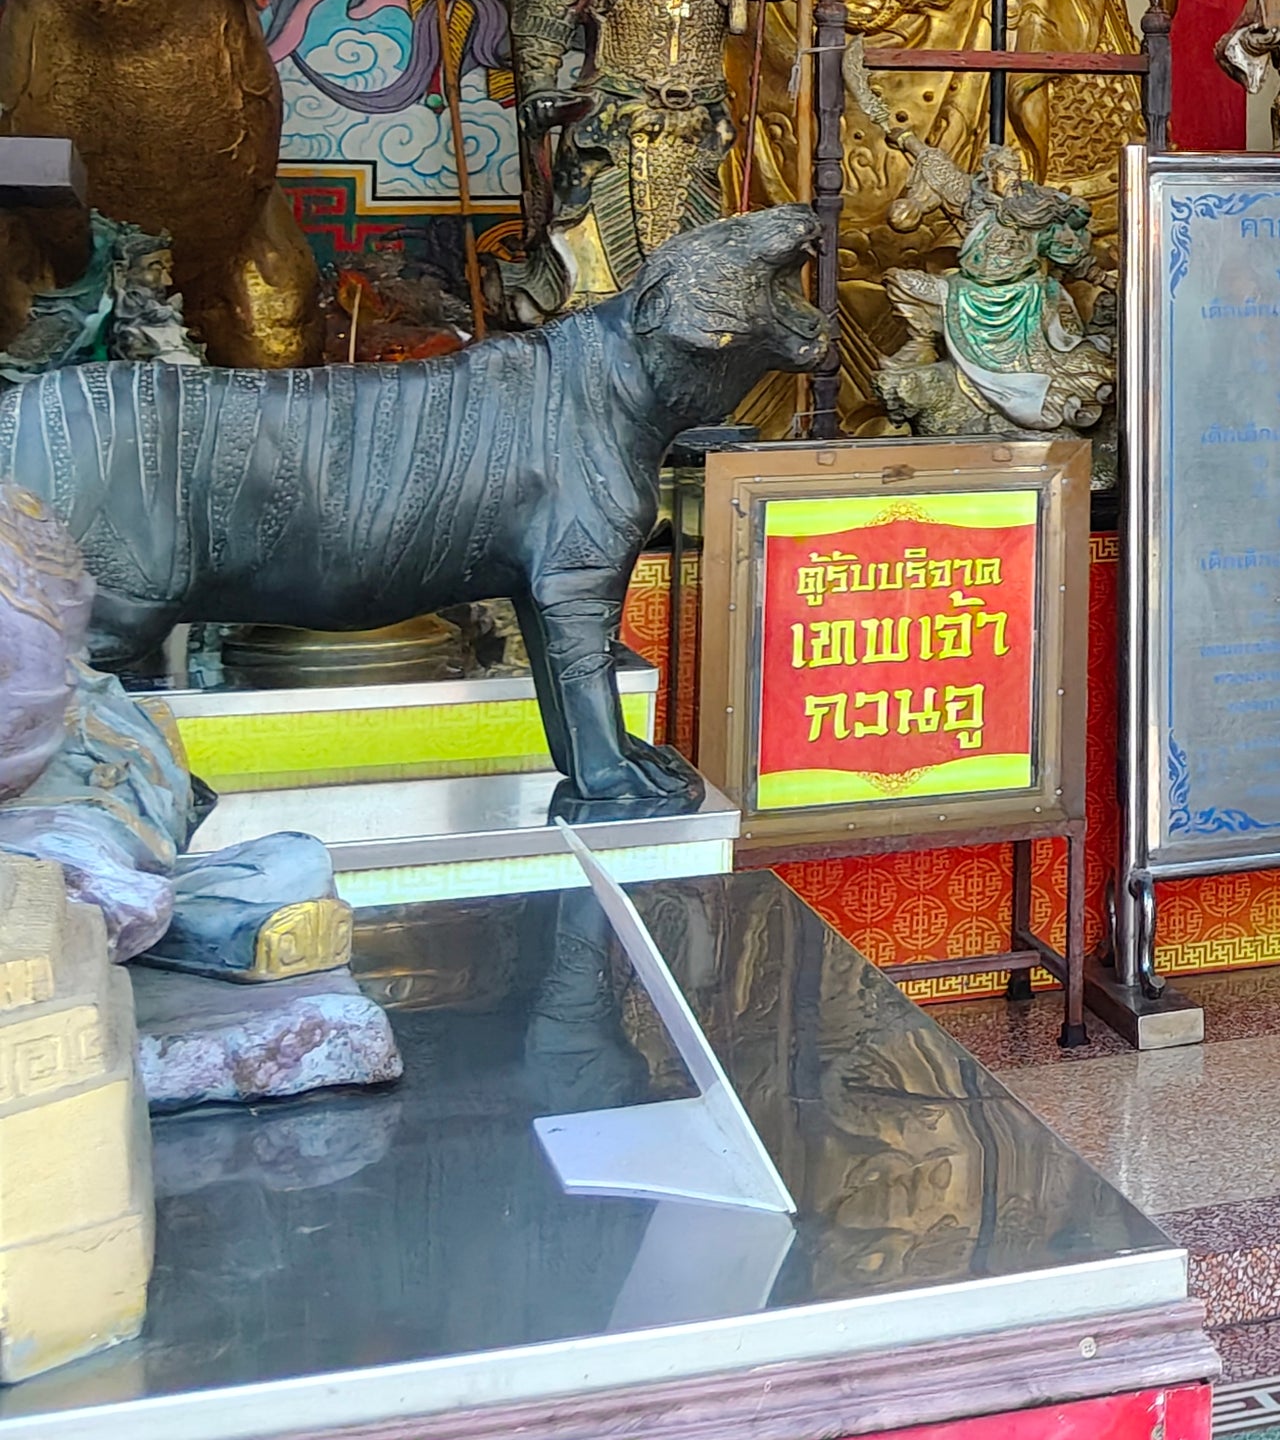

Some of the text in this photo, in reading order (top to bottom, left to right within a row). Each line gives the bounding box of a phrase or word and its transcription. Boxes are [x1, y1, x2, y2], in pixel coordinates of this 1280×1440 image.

[797, 547, 1002, 607] ตู้รับบริจาค
[790, 590, 1010, 669] เทพเจ้า
[803, 683, 985, 750] กวนอู
